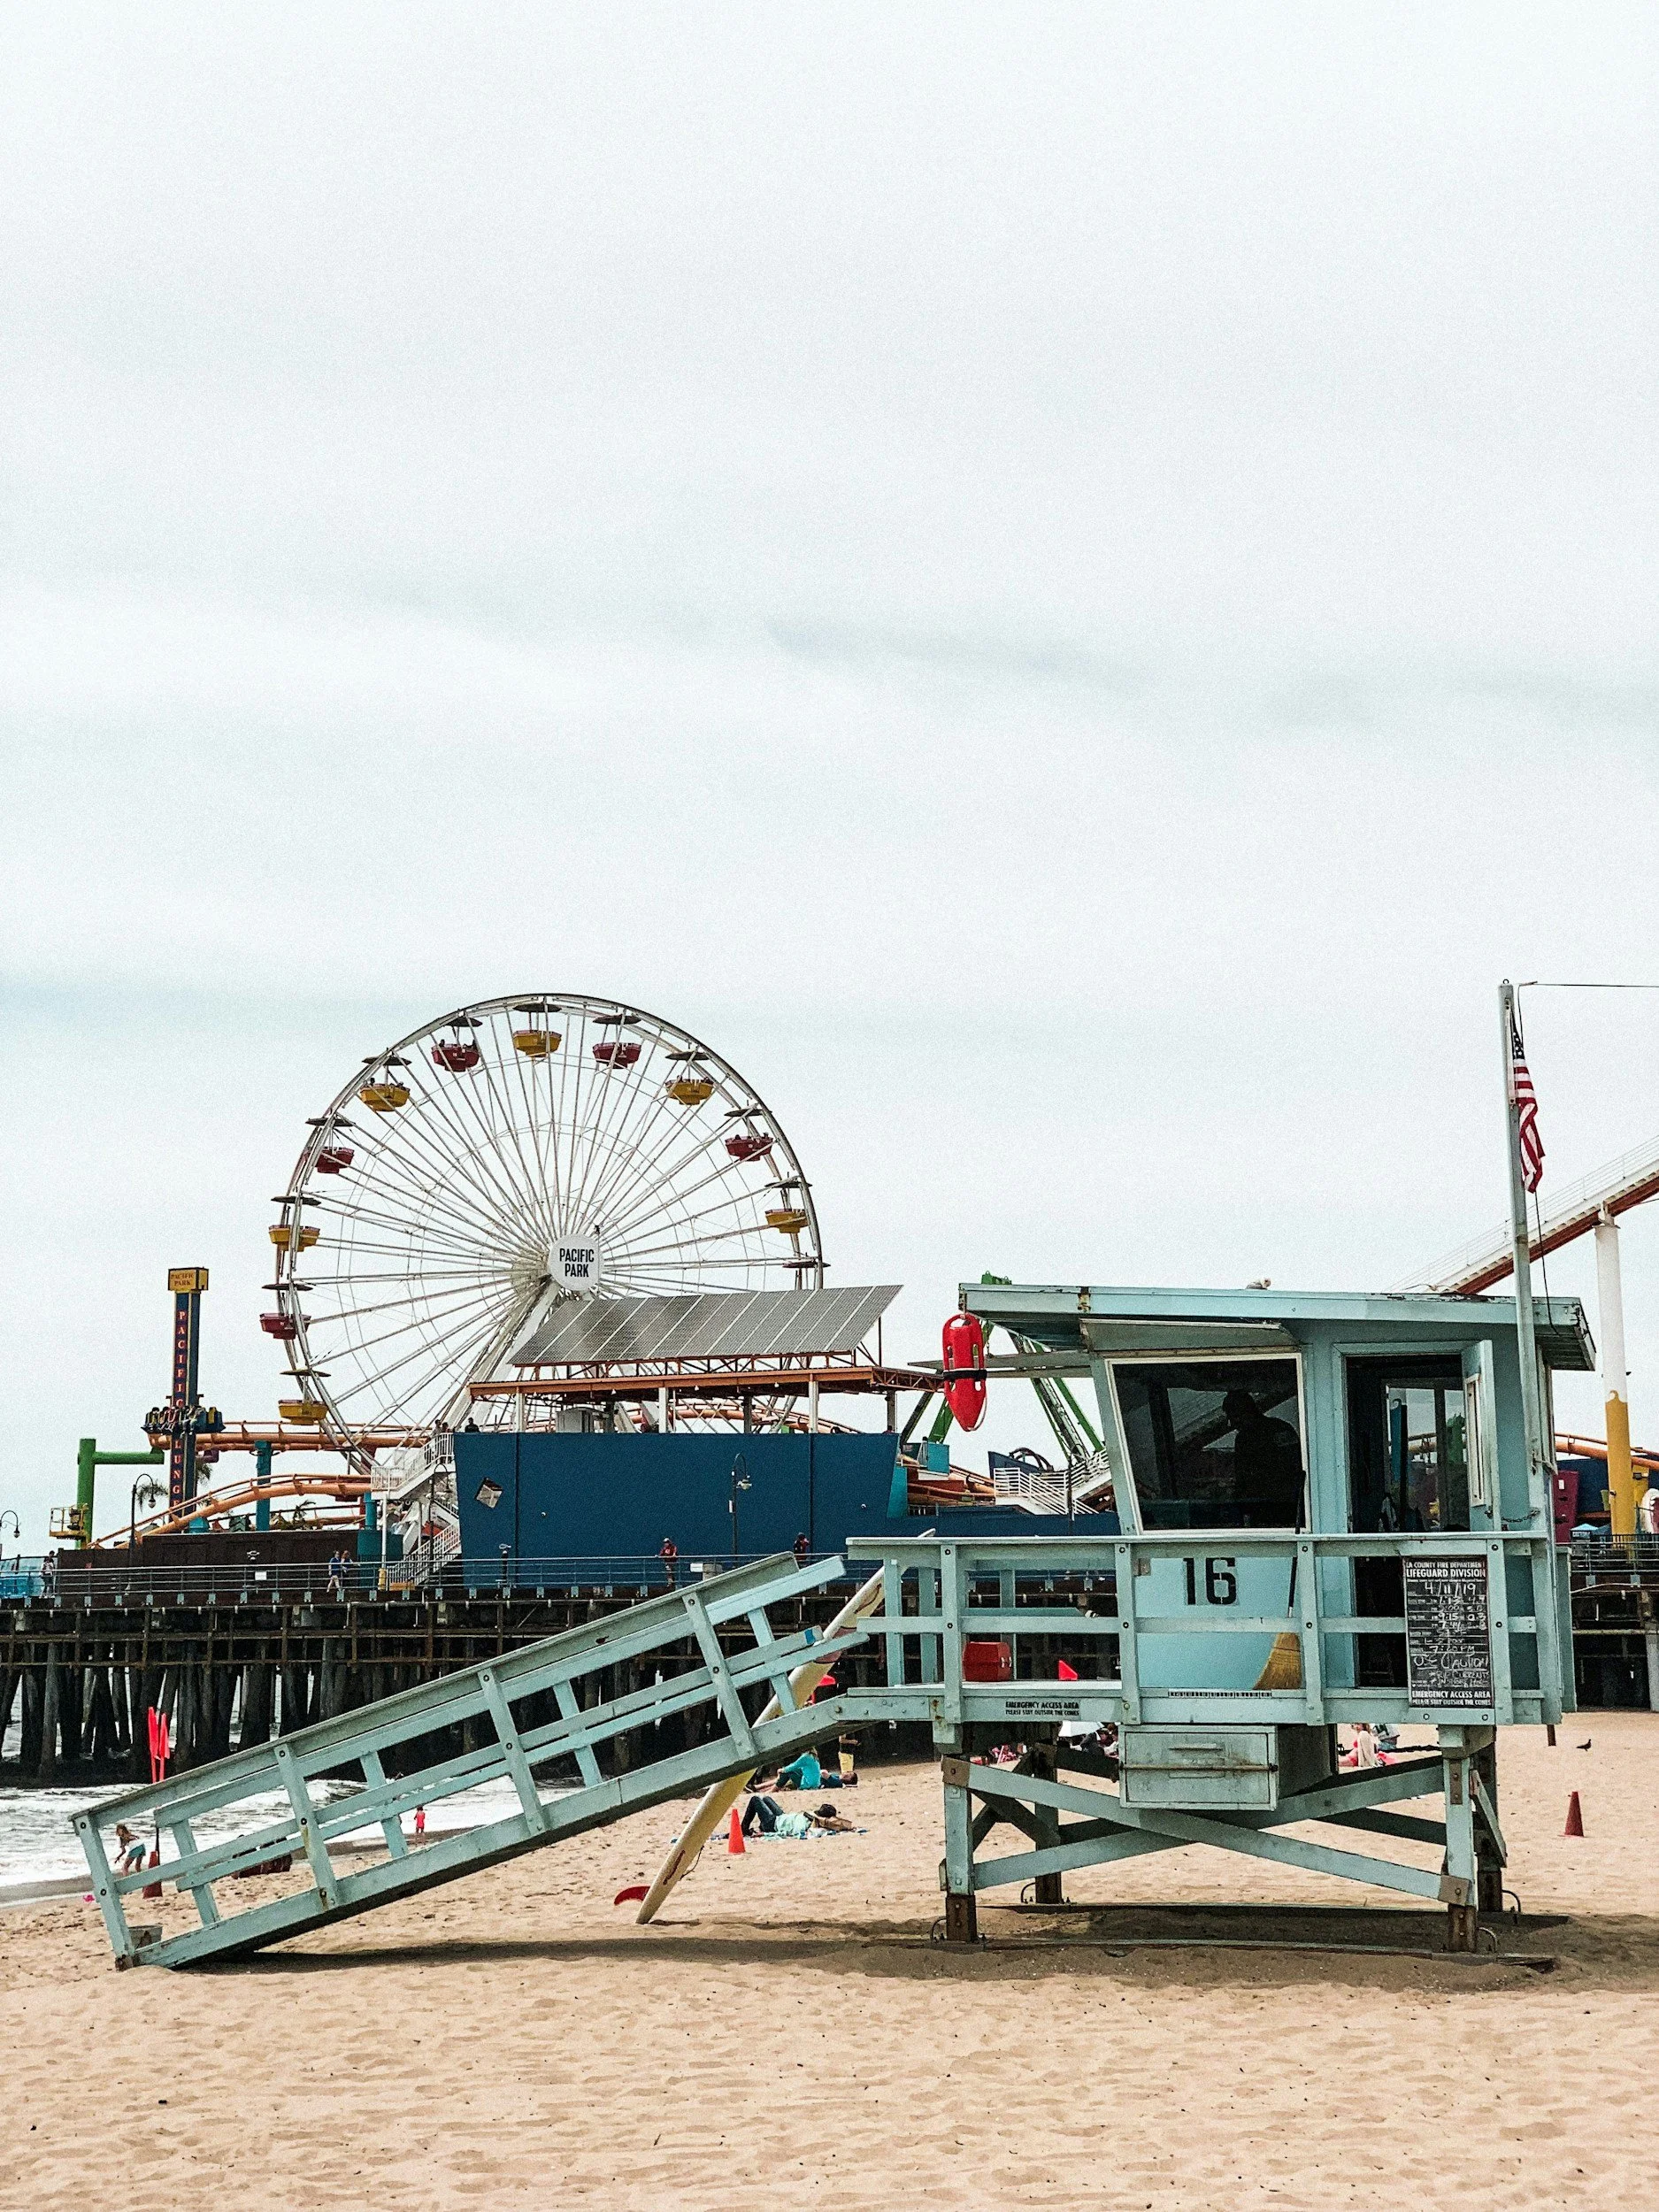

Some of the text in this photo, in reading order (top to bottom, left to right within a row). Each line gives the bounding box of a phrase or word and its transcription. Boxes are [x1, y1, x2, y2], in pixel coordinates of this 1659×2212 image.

[559, 1248, 595, 1263] PACIFIC
[565, 1263, 589, 1278] PARK
[176, 1310, 186, 1409] PACIFIC
[1405, 1568, 1486, 1578] LIFEGUARD DIVISION
[1182, 1557, 1237, 1605] 16
